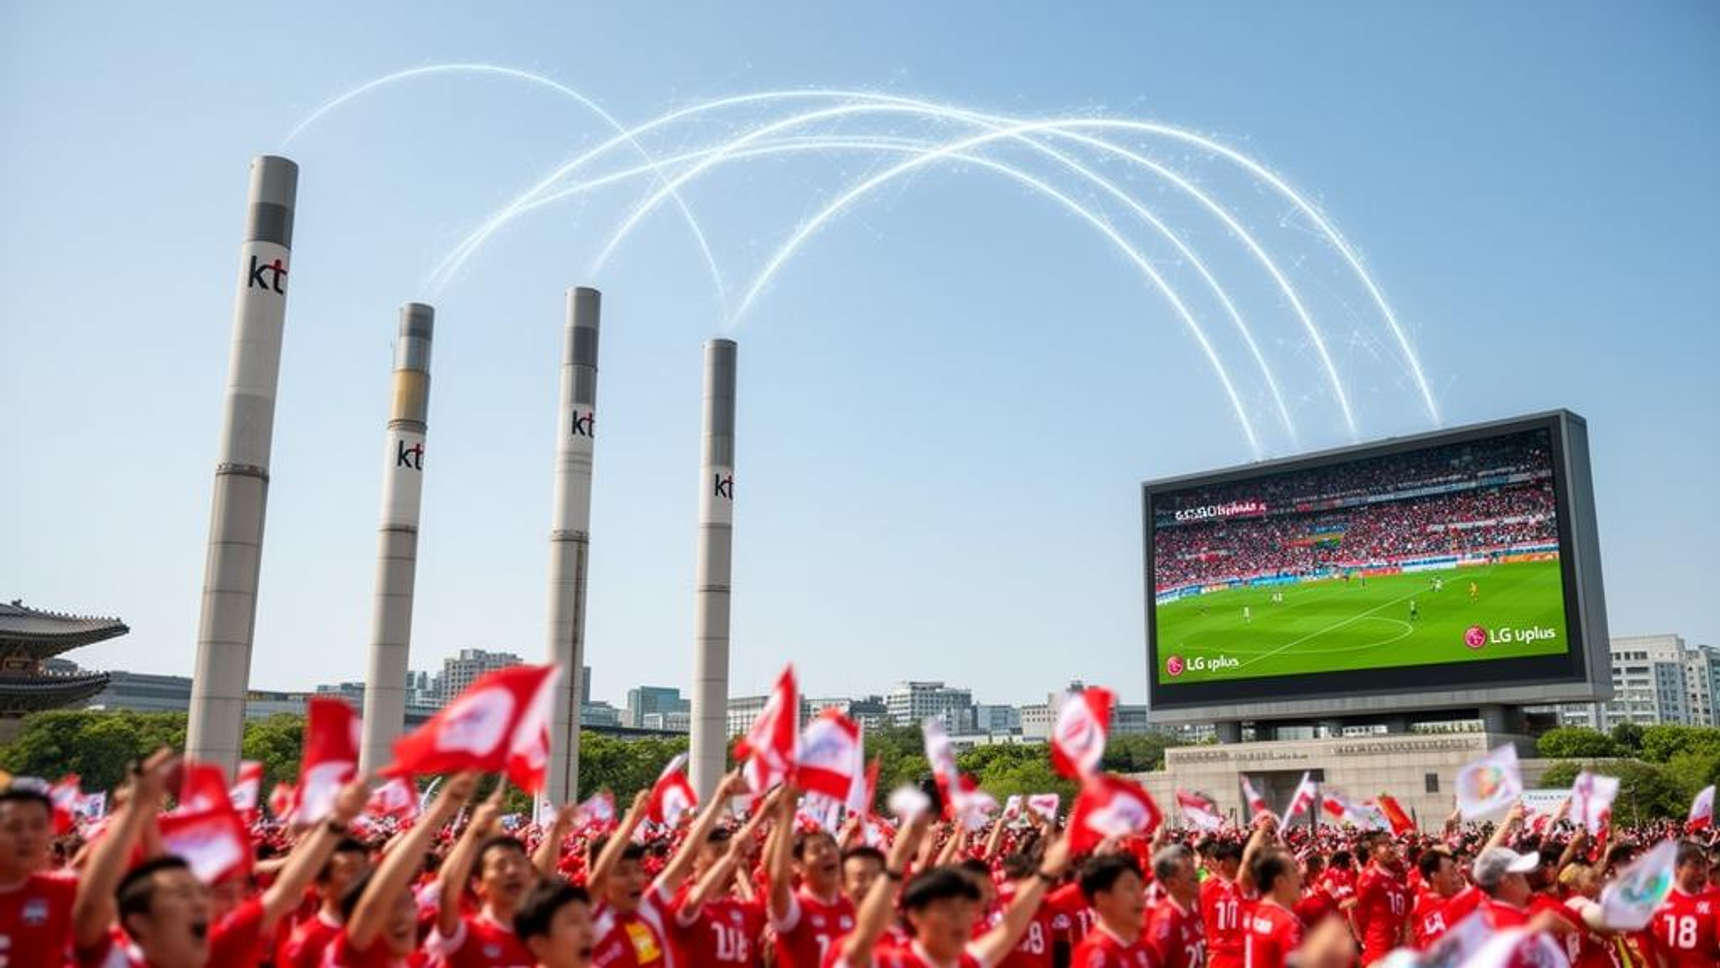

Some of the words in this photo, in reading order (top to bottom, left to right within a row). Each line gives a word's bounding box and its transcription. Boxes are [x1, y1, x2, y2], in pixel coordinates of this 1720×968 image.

[248, 255, 287, 296] kt
[571, 410, 595, 439] kt
[397, 440, 424, 471] kt
[714, 473, 734, 500] kt
[1489, 628, 1512, 643] LG
[1186, 656, 1205, 671] LG
[1663, 914, 1698, 949] 18
